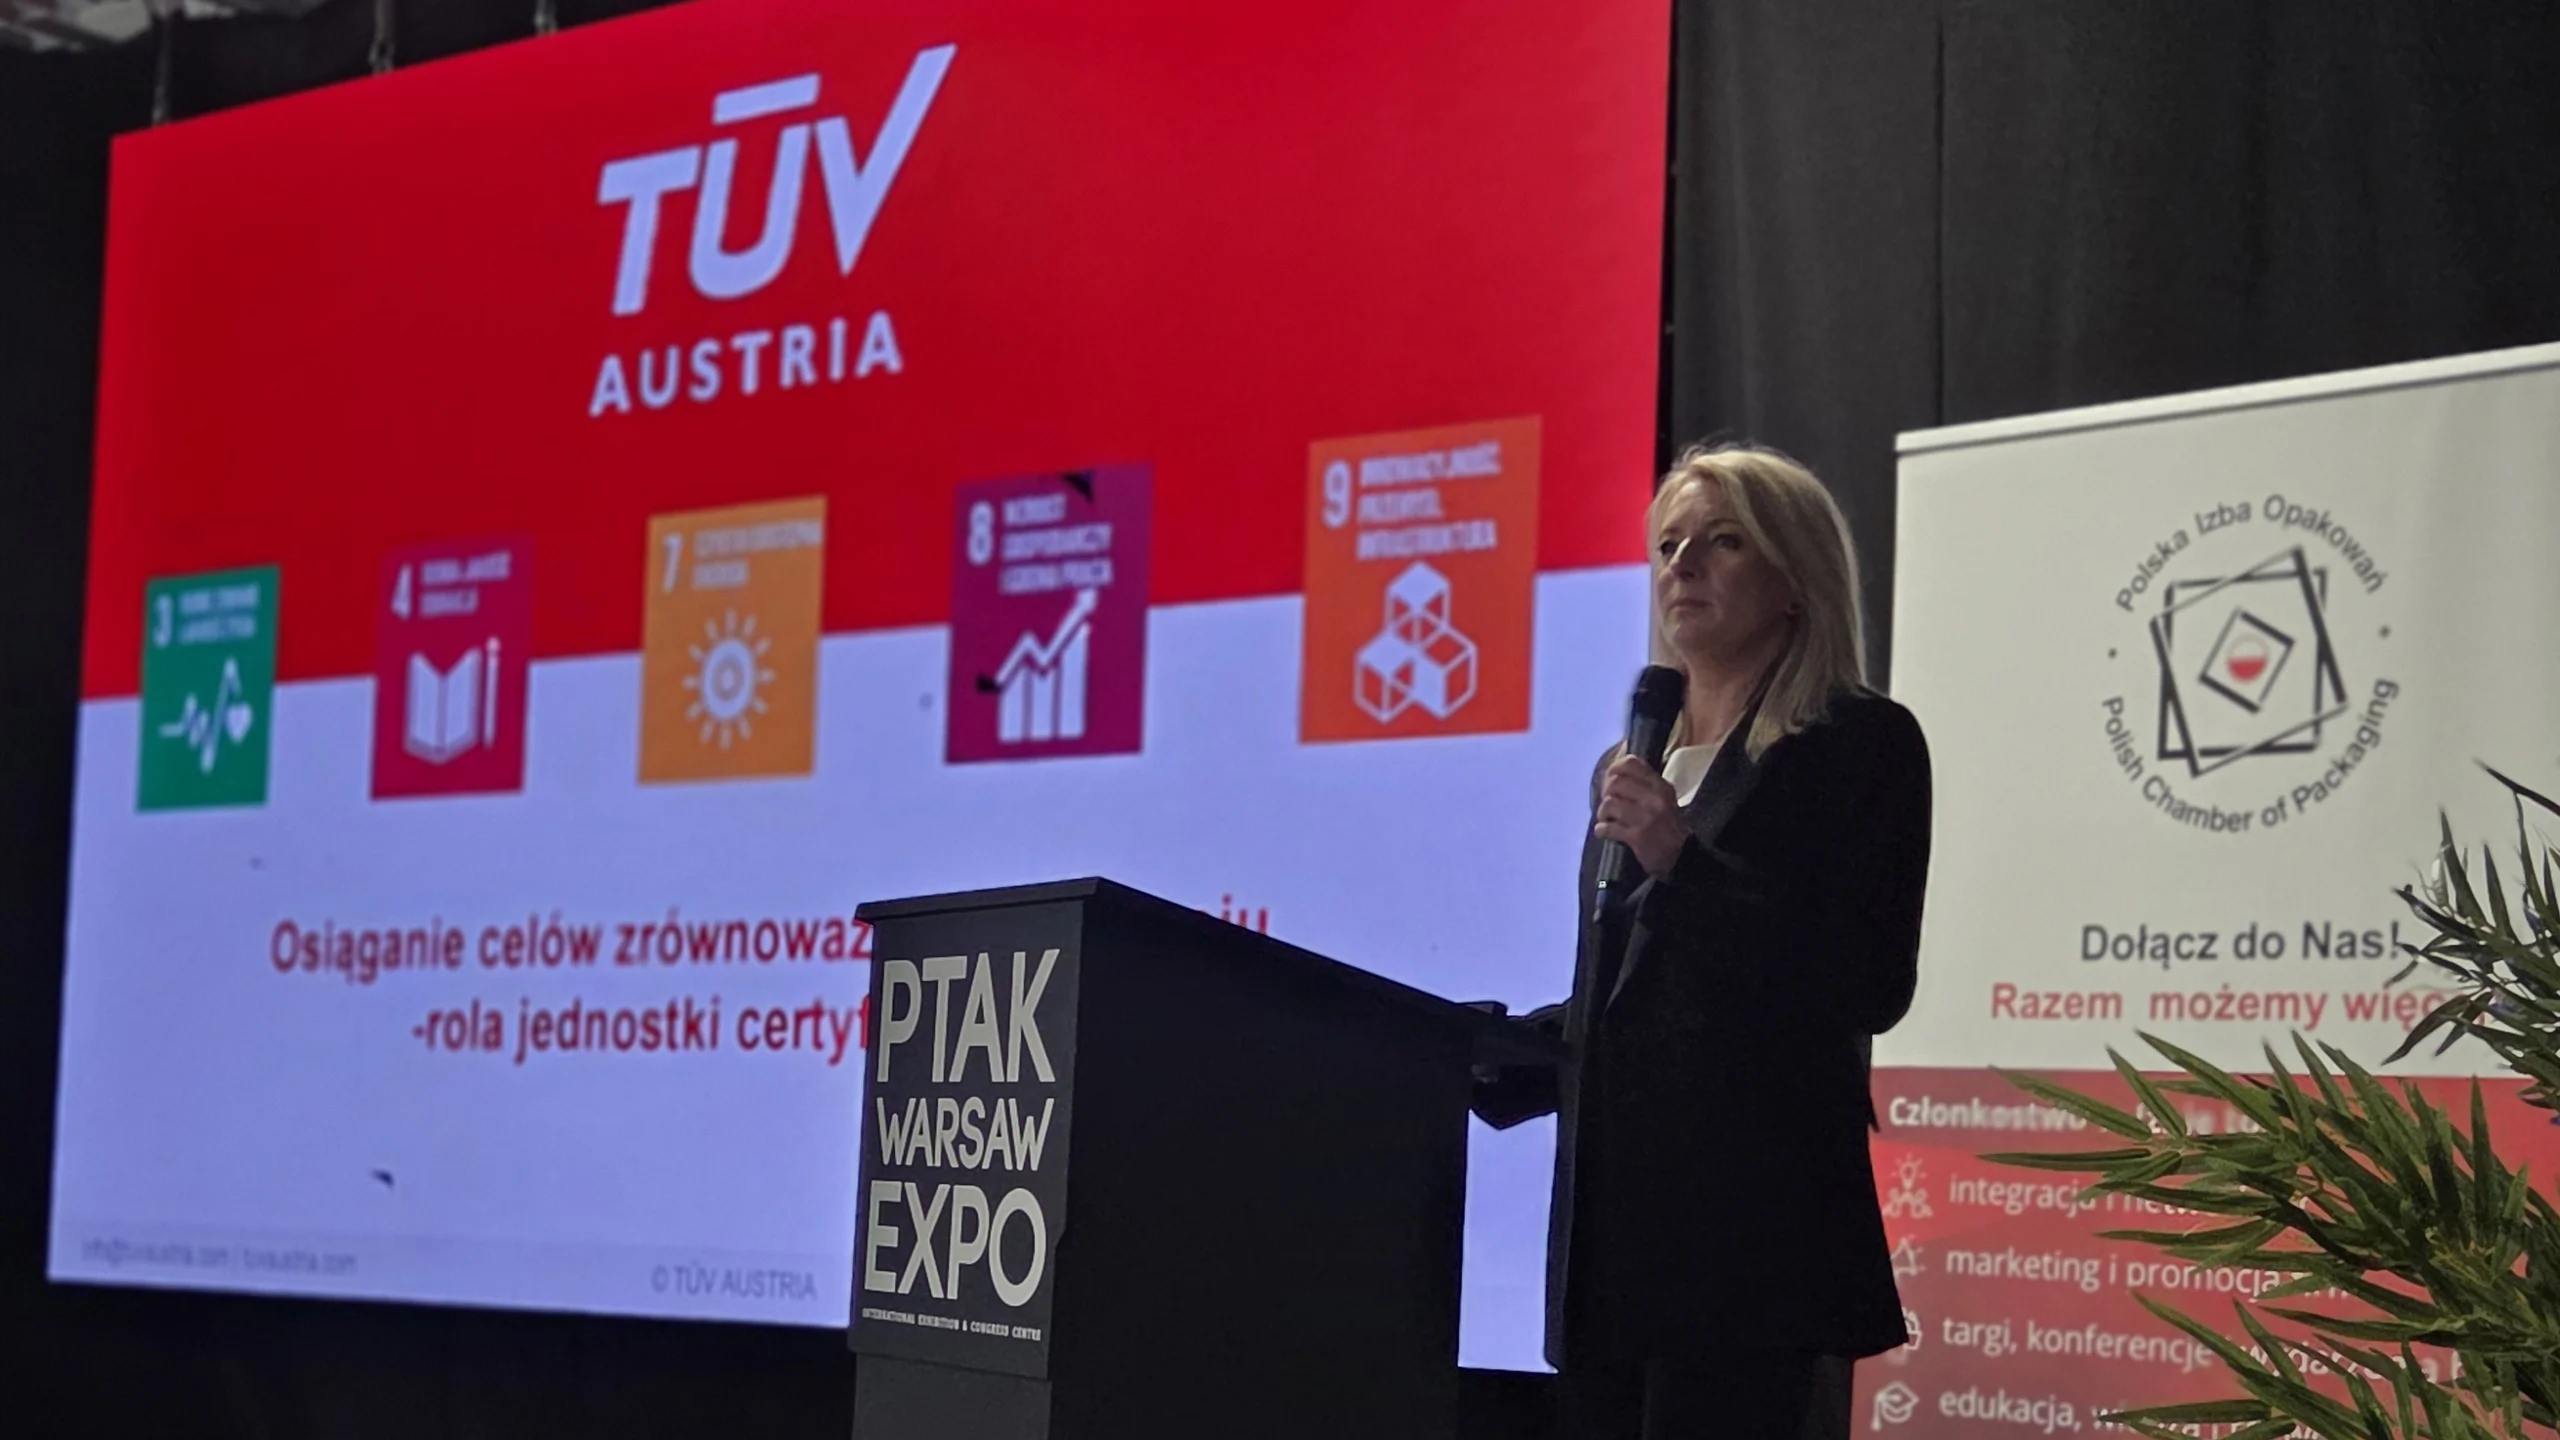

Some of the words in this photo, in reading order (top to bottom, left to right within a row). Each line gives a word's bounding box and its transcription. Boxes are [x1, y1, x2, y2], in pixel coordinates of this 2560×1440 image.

[588, 310, 903, 418] AUSTRIA
[1322, 460, 1350, 530] 9
[663, 532, 682, 593] 7
[968, 502, 993, 565] 8
[2116, 529, 2190, 613] Polska
[2194, 500, 2252, 536] Izba
[2262, 493, 2390, 595] Opakowań
[391, 564, 413, 620] 4
[2102, 696, 2145, 783] Polish
[2142, 774, 2255, 834] Chamber
[2260, 796, 2289, 829] of
[2292, 677, 2400, 815] Packaging
[270, 919, 465, 984] Osiąganie
[478, 911, 602, 968] celów
[2080, 923, 2219, 971] Dołącz
[2232, 922, 2286, 960] do
[2301, 920, 2400, 961] Nas!
[514, 994, 721, 1066] jednostki
[877, 948, 1060, 1083] PTAK
[1991, 982, 2123, 1020] Razem
[2148, 982, 2328, 1032] możemy
[876, 1096, 1054, 1171] WARSAW
[864, 1180, 1047, 1307] EXPO
[1945, 1246, 2101, 1293] marketing
[2109, 1253, 2117, 1284] i
[721, 1267, 818, 1302] AUSTRIA
[1943, 1315, 2018, 1358] targi,
[2027, 1319, 2213, 1374] konferencje
[1938, 1384, 2082, 1434] edukacja,
